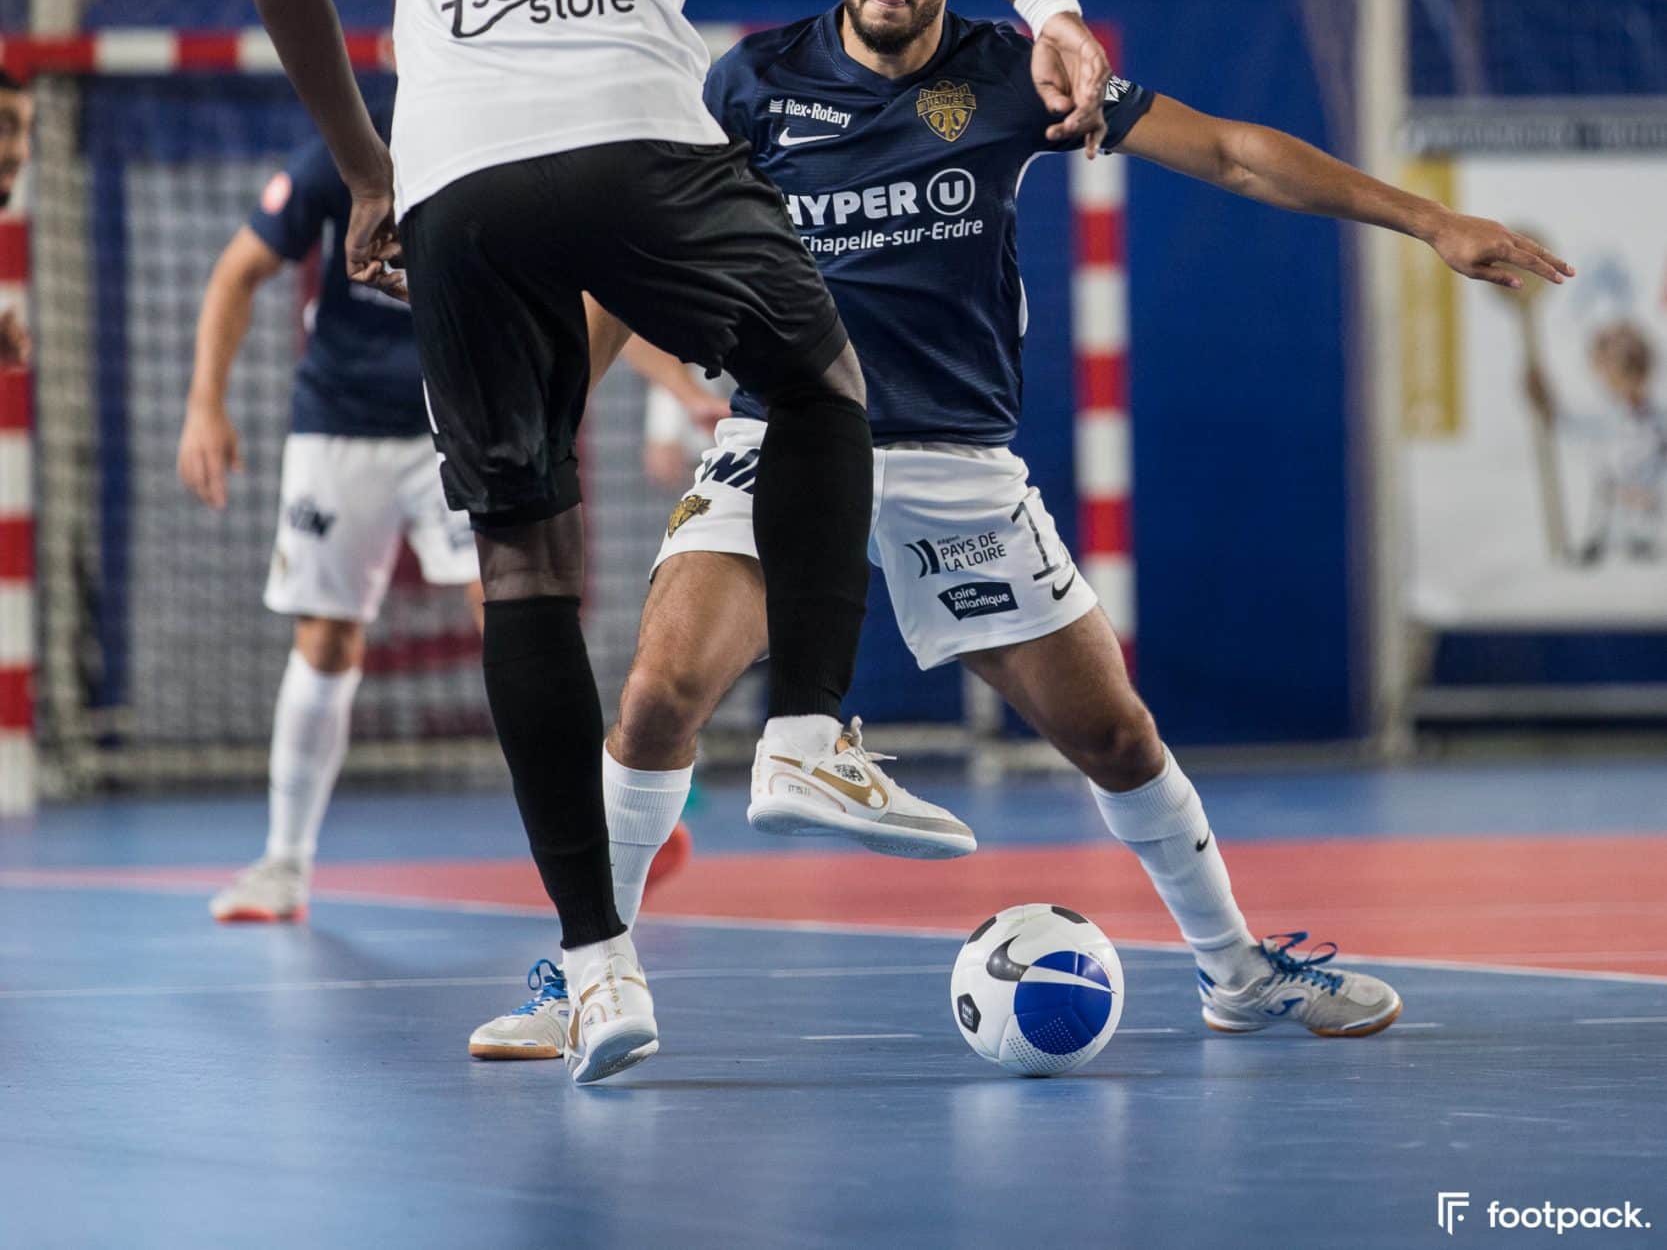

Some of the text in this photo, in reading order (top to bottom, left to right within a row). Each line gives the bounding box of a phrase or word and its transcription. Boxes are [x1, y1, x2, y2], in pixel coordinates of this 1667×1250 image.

[940, 531, 999, 560] PAYS DE
[944, 543, 1007, 573] LA LOIRE
[947, 588, 977, 601] Loire
[954, 593, 1010, 611] Atlantique
